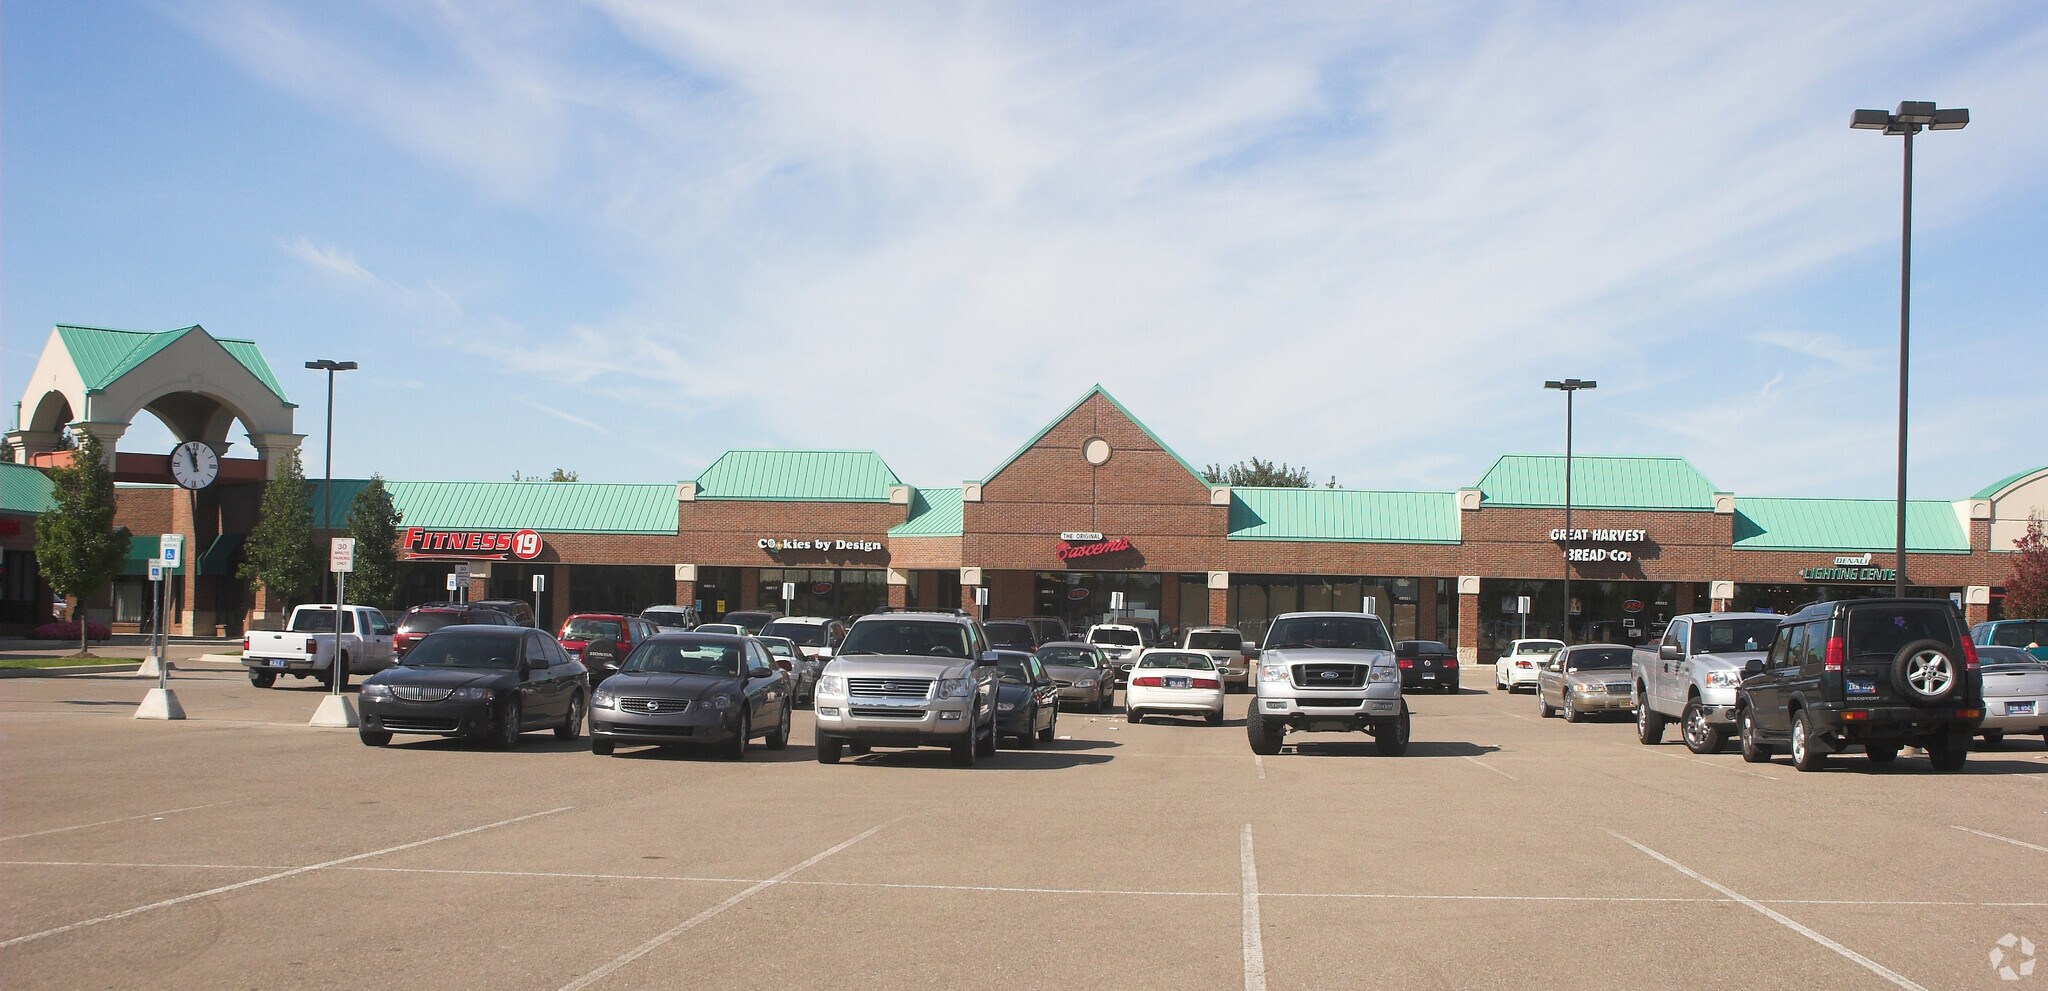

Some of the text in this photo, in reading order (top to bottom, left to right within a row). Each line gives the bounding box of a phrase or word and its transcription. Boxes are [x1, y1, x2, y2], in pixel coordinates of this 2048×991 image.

[403, 527, 537, 554] FITNESS 19
[1550, 529, 1645, 541] GREAT HARVEST
[815, 539, 831, 551] by
[836, 540, 881, 552] Design
[1563, 548, 1606, 561] BREAD
[1803, 567, 1897, 580] LIGHTING CENTE
